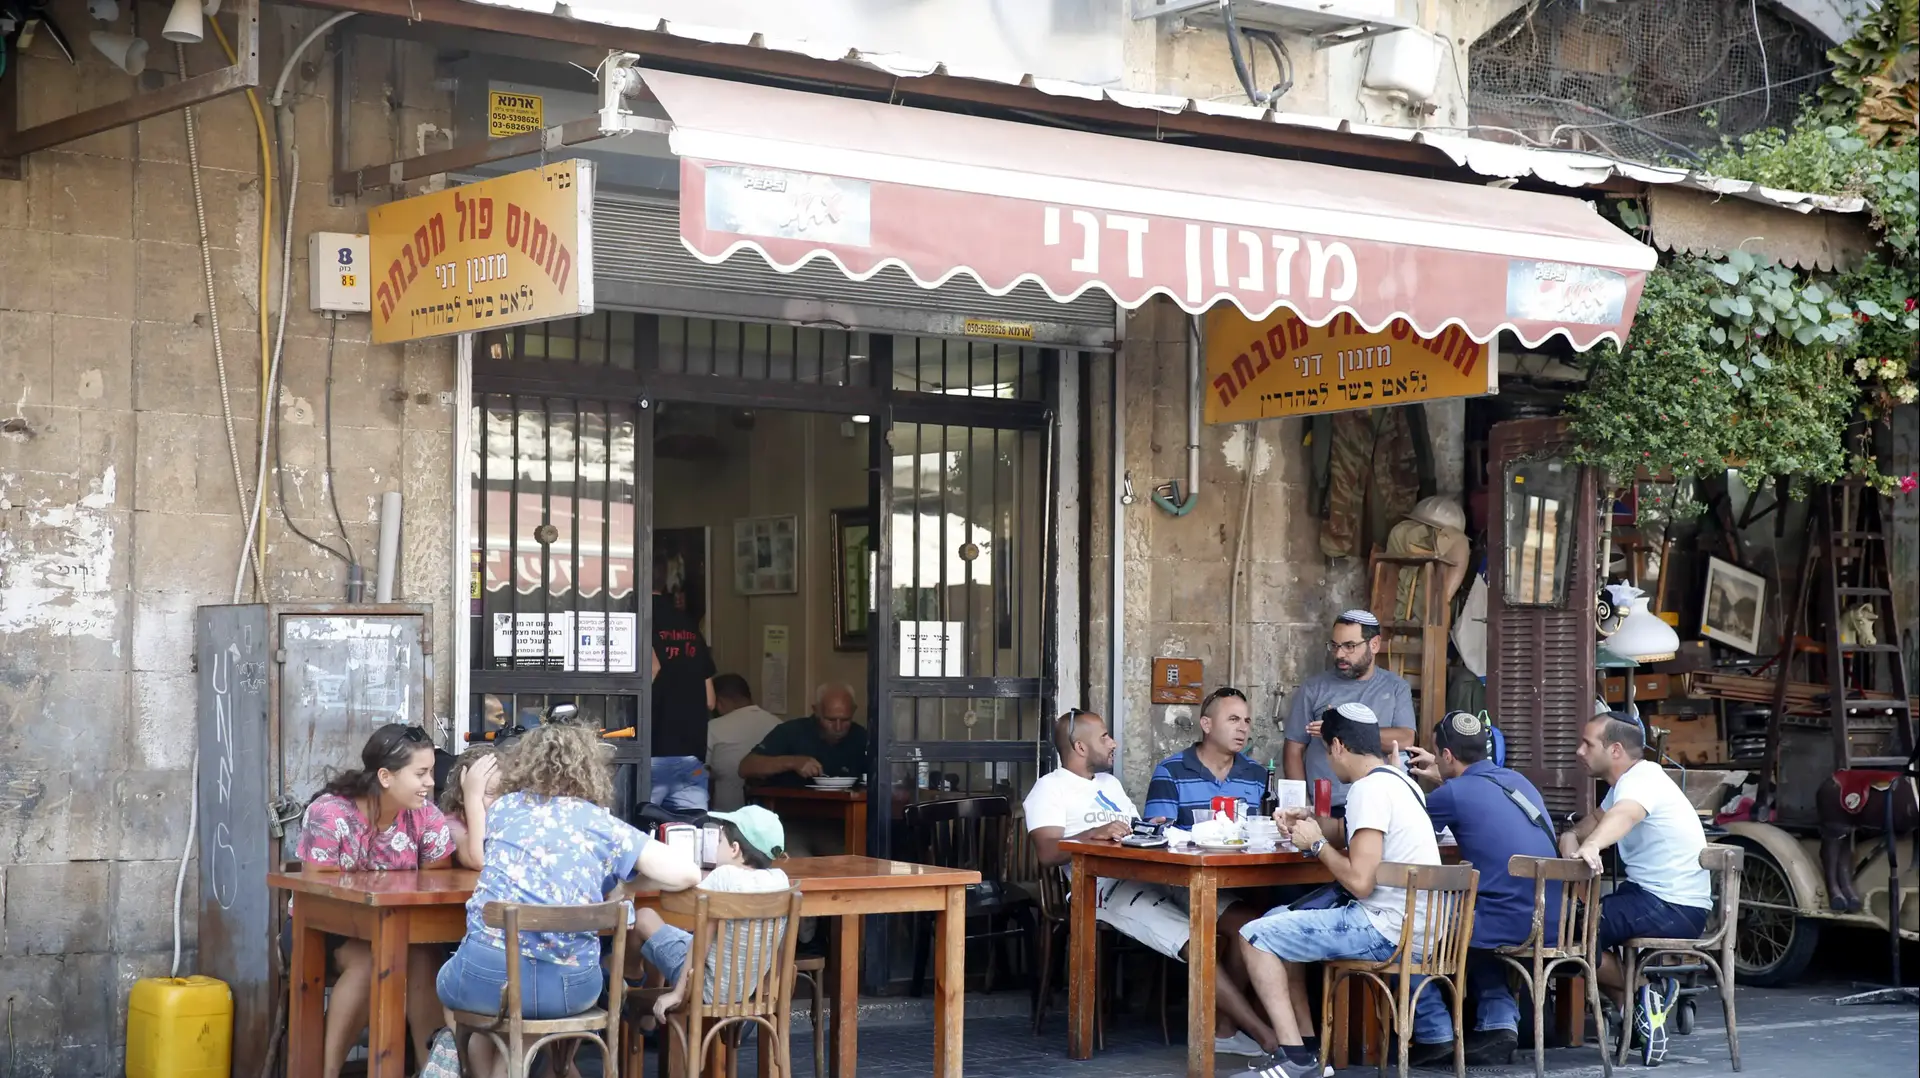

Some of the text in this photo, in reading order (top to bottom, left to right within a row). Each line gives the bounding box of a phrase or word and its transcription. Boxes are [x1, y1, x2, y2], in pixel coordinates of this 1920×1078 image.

[493, 113, 539, 124] 050-5398626
[498, 95, 534, 109] ארמא
[744, 176, 788, 193] PEPSI
[376, 212, 446, 324] מסבחה
[506, 202, 571, 296] חומוס
[1044, 206, 1358, 303] מזנון דני
[435, 252, 508, 294] מזנון דני
[1535, 268, 1567, 282] PEPSI
[411, 284, 534, 335] גלאט כשר למהדרין
[1008, 326, 1030, 337] ארמא
[1213, 315, 1309, 408] מסבחה
[1293, 344, 1392, 380] מזנון דני
[1260, 370, 1428, 417] גלאט כשר למהדרין
